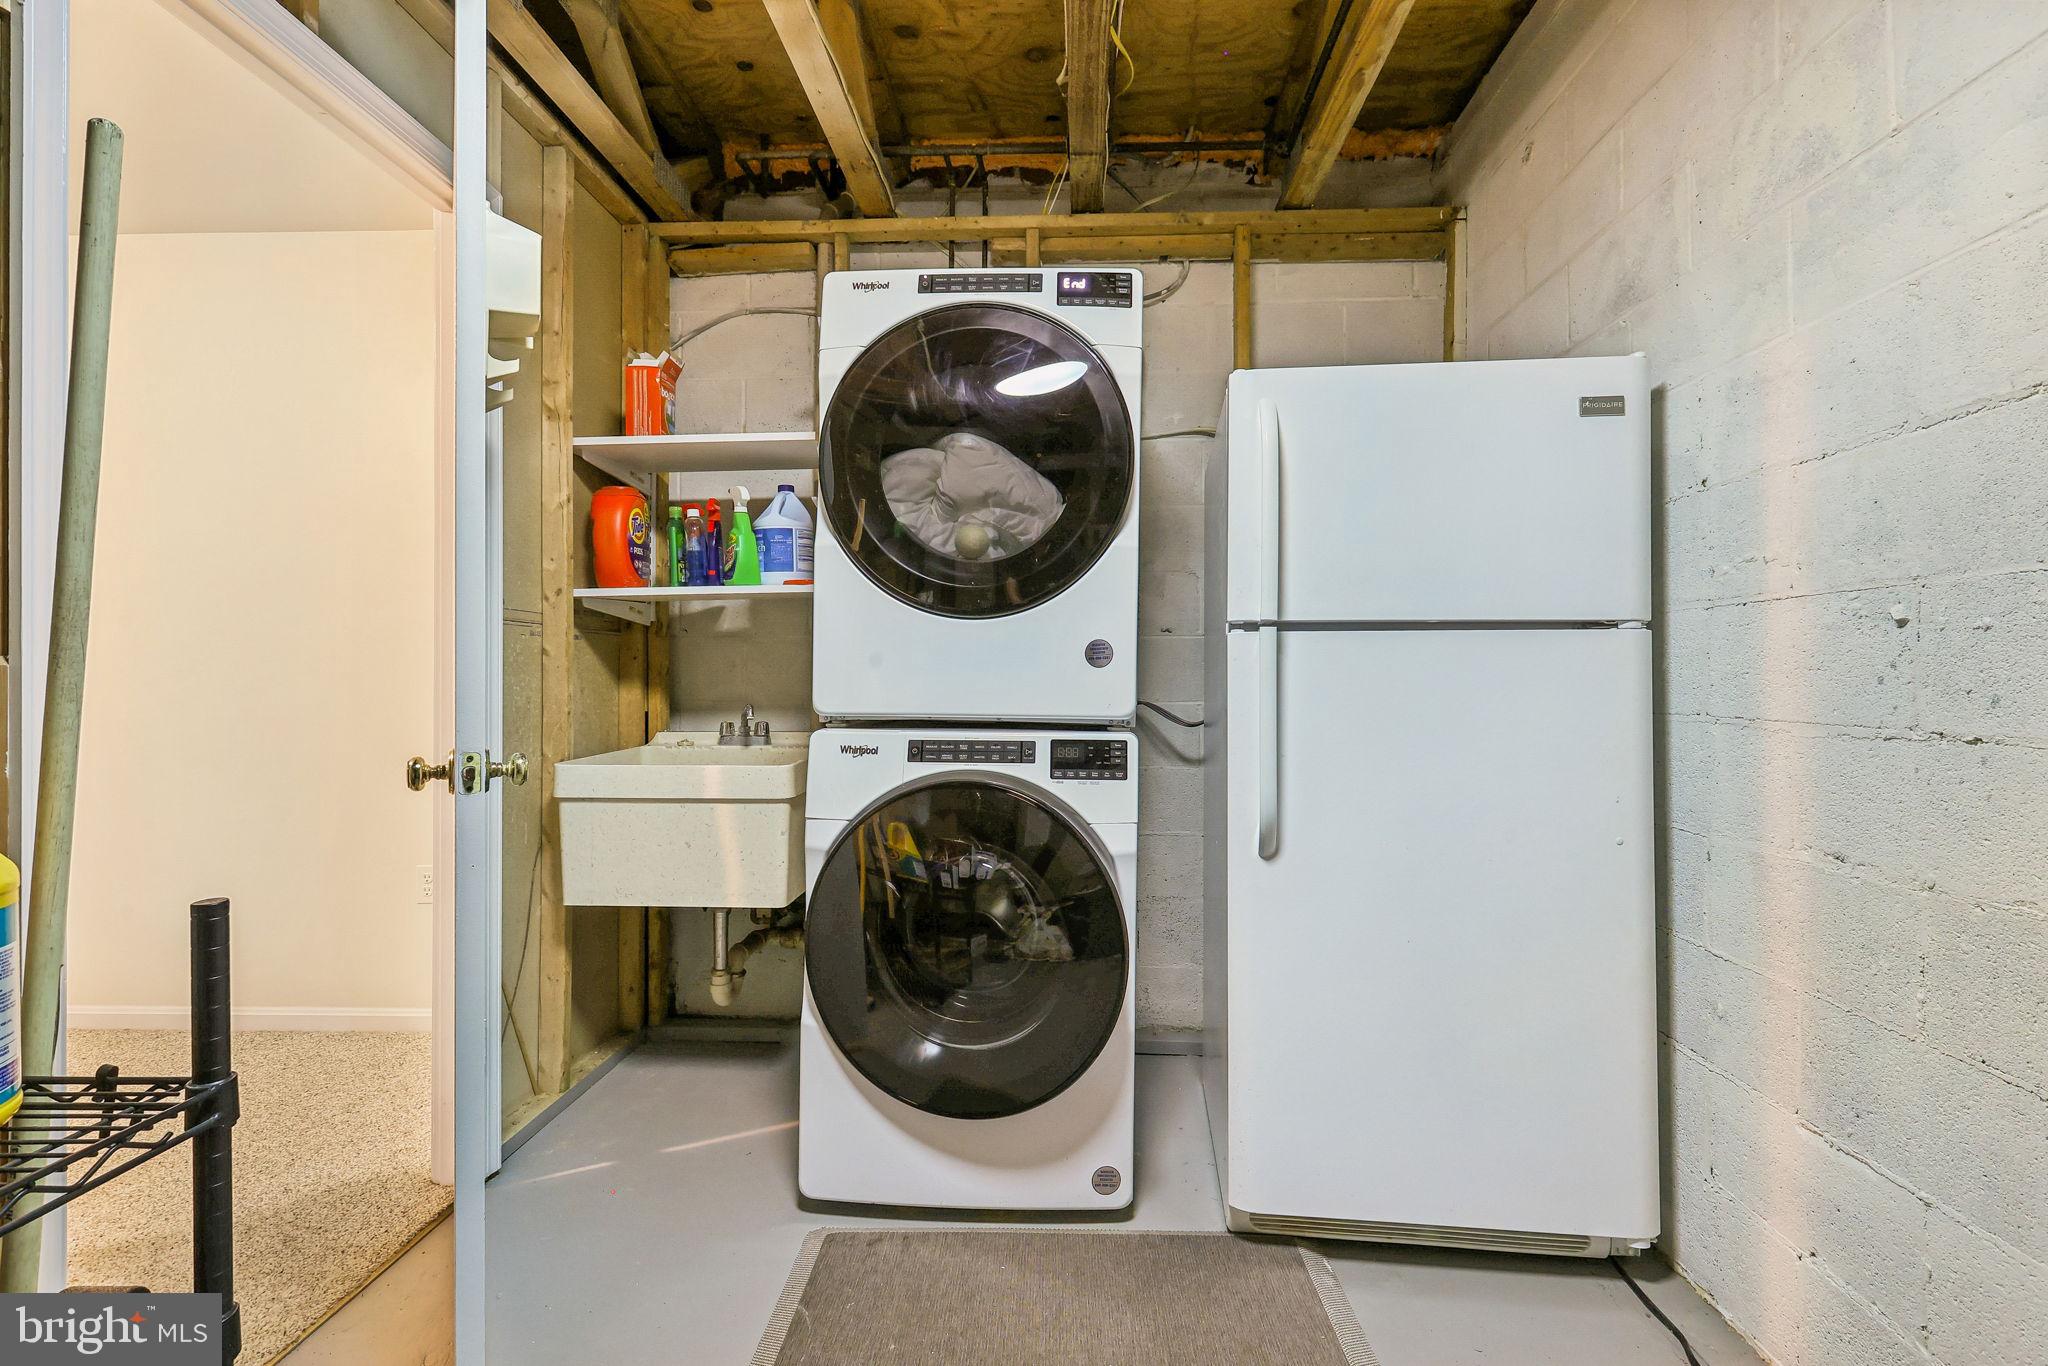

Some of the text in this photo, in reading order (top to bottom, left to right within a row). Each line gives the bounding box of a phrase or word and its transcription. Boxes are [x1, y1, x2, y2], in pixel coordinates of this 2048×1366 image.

[852, 281, 890, 293] Whirlpool
[1063, 277, 1086, 289] End
[631, 516, 644, 536] Tide
[840, 745, 879, 758] Whirlpool
